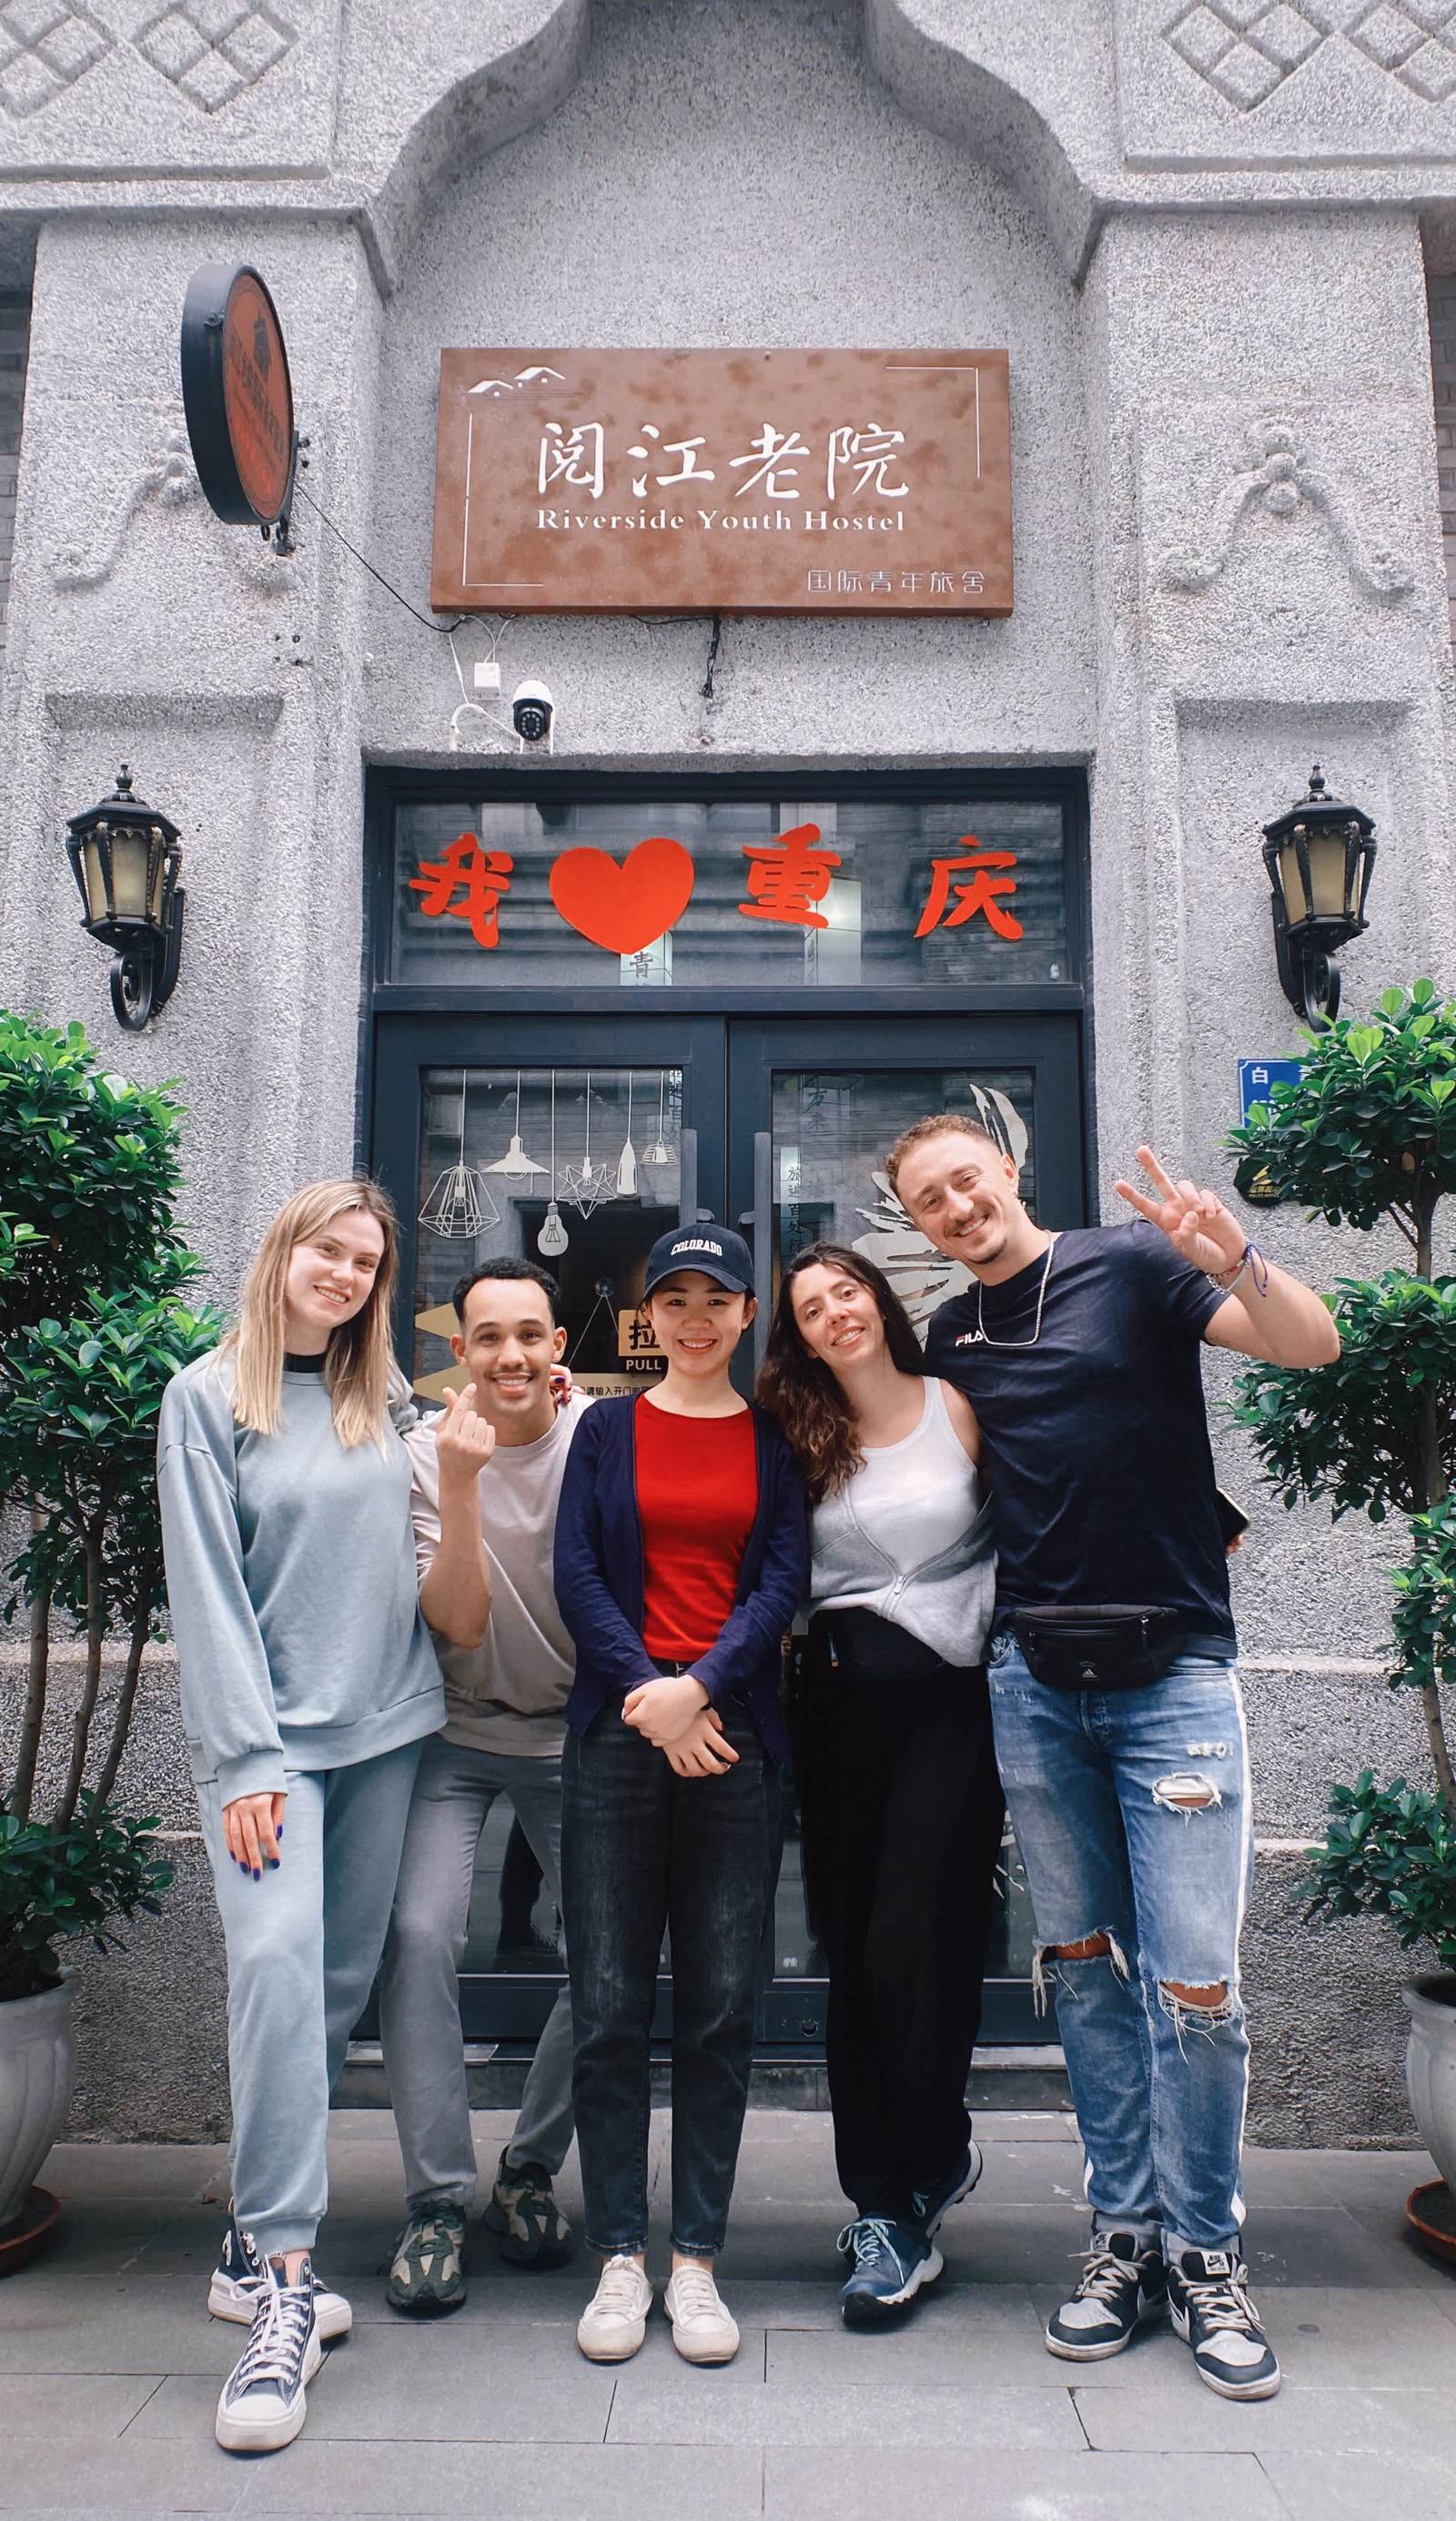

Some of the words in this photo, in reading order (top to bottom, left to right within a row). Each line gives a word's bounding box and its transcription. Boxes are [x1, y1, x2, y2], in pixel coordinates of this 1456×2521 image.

[538, 421, 910, 501] 阅江老院
[538, 509, 684, 530] Riverside
[696, 510, 792, 531] Youth
[804, 511, 904, 532] Hostel
[807, 569, 985, 593] 国际青年旅舍
[410, 834, 512, 948] 我
[738, 823, 1023, 940] 重庆
[671, 1239, 723, 1257] COLORADO
[629, 1319, 661, 1351] 拉
[955, 1330, 985, 1347] FILA
[625, 1359, 662, 1372] PULL
